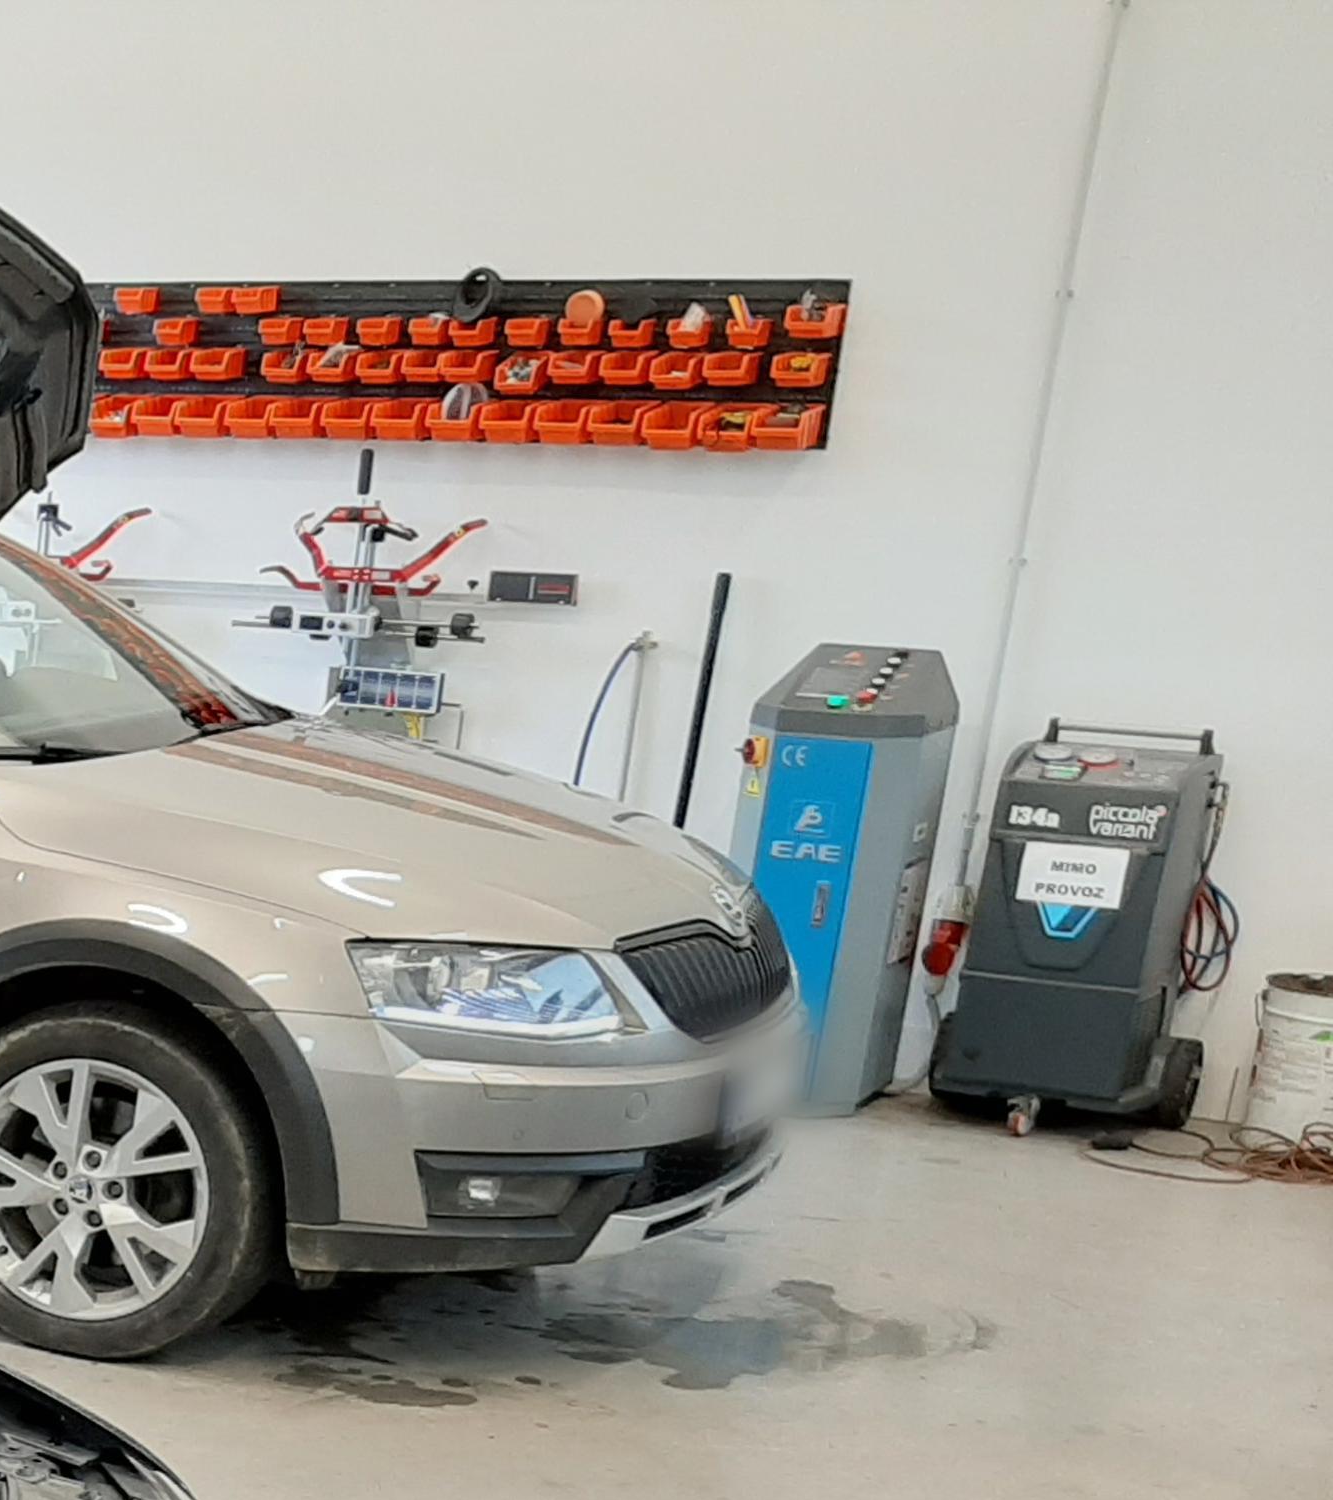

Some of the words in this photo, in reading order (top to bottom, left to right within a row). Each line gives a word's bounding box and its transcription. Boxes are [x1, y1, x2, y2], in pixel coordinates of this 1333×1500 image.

[1089, 801, 1159, 824] piccola
[771, 839, 842, 863] EAE
[1049, 860, 1098, 875] MIMO
[1034, 882, 1106, 899] PROVOZ
